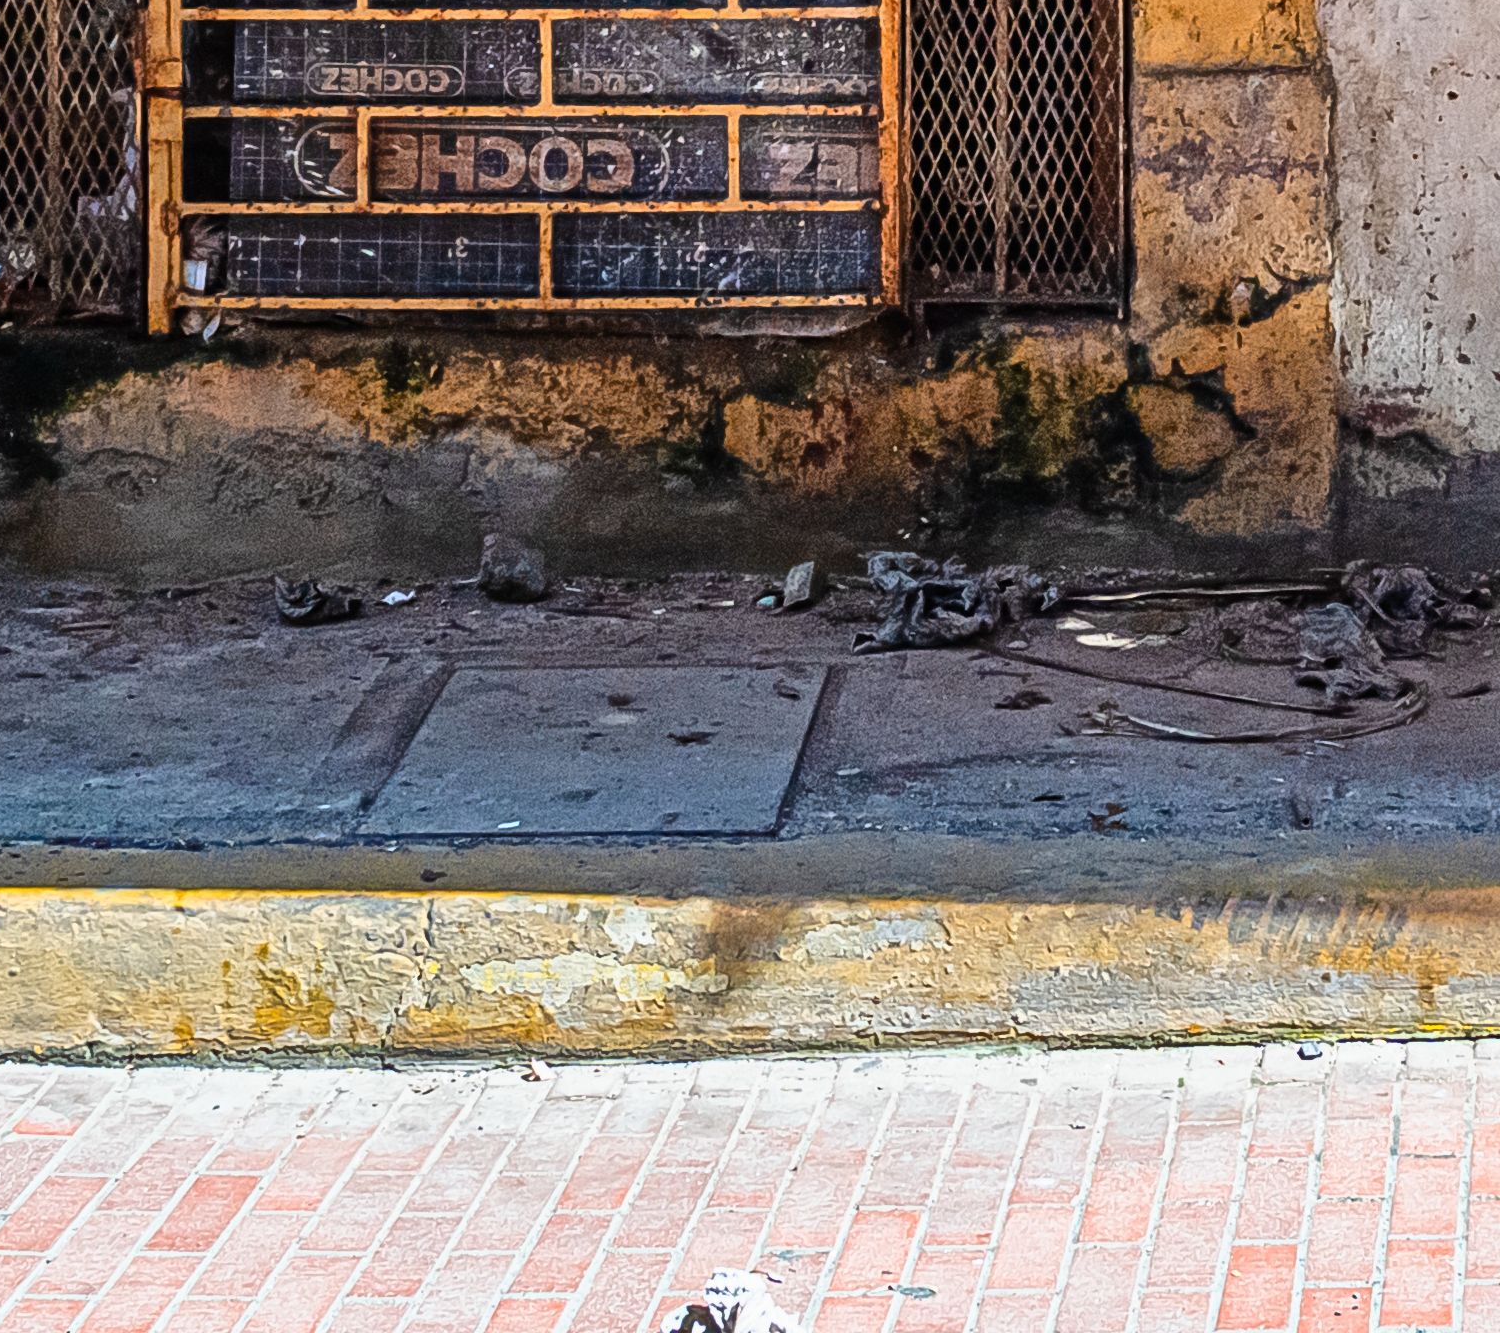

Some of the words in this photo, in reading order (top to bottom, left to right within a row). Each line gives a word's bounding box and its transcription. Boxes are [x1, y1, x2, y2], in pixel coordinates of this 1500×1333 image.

[320, 67, 451, 94] COCHEZ
[516, 69, 654, 96] COCHZ
[328, 132, 635, 193] COCHEZ
